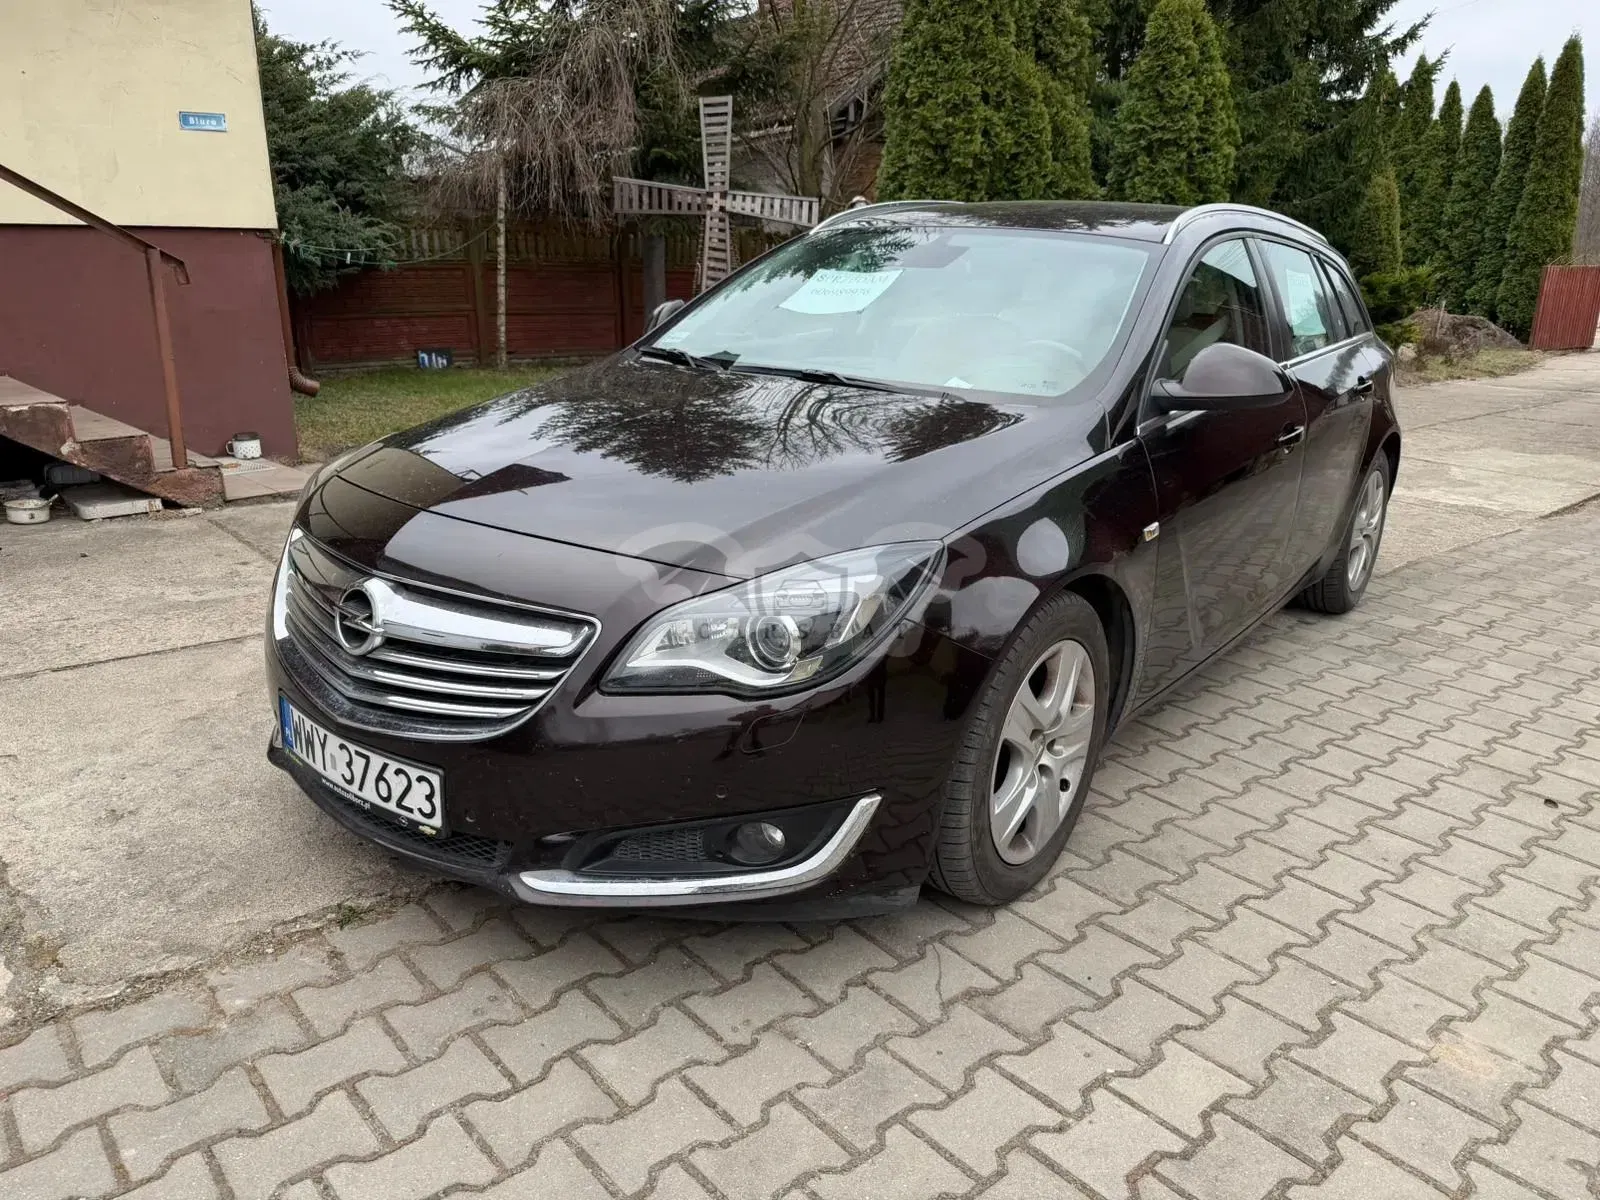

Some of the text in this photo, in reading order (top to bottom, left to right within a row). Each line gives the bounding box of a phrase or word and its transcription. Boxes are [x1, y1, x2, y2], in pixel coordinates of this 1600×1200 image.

[188, 116, 217, 126] Biuro
[290, 707, 437, 820] WWY 37623
